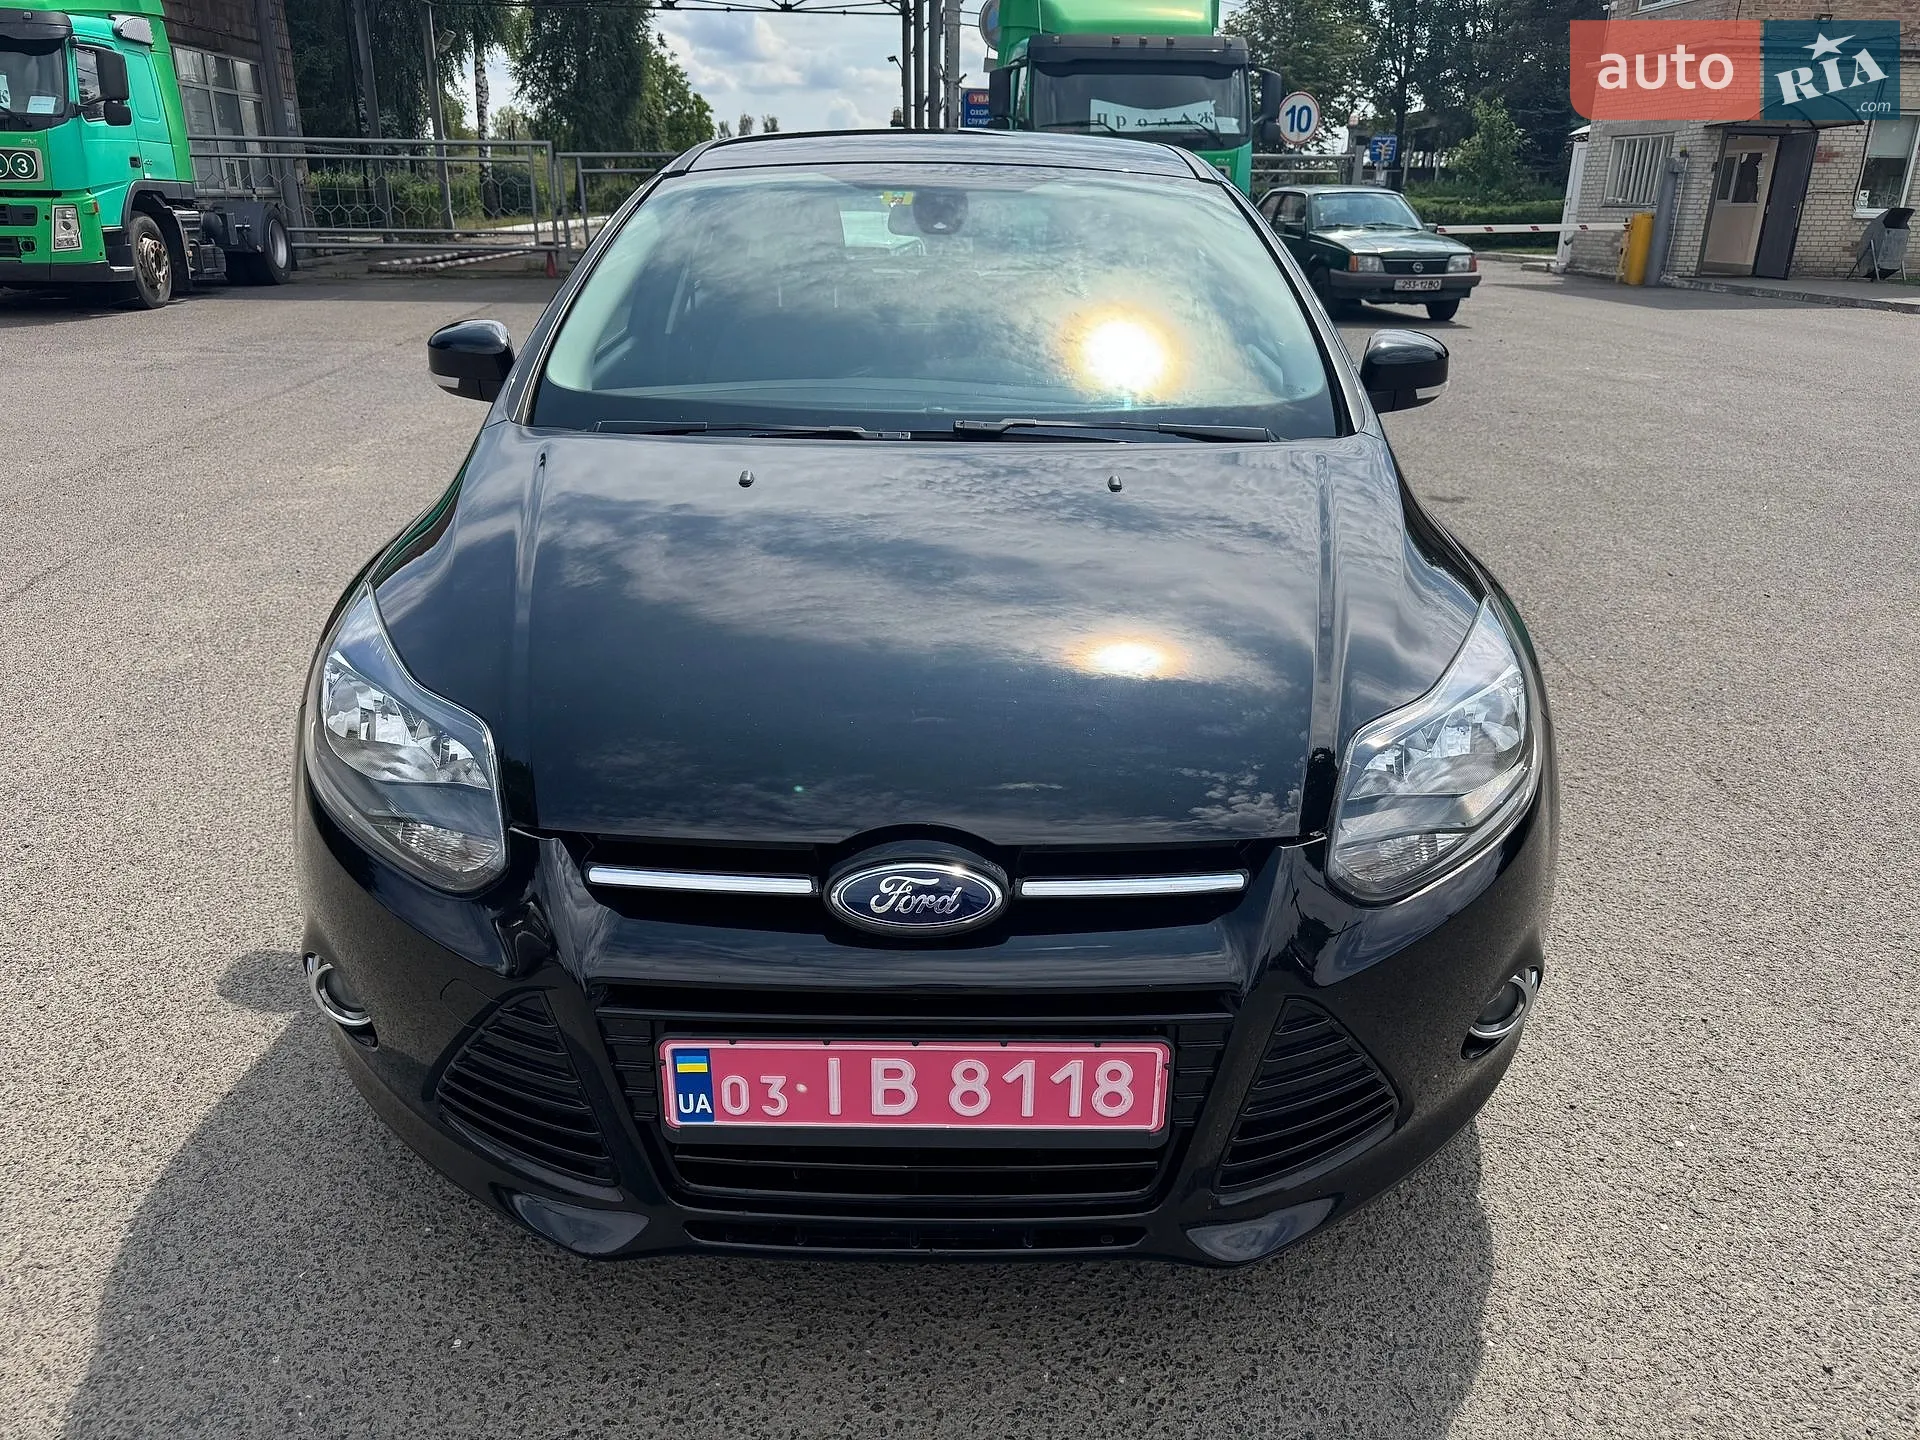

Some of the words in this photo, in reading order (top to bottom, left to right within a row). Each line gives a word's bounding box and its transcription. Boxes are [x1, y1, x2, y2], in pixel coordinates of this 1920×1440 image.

[971, 94, 990, 103] УВА
[1285, 105, 1313, 133] 10
[17, 158, 28, 173] 3
[870, 875, 962, 914] Ford
[678, 1093, 712, 1114] UA
[721, 1075, 788, 1116] 03
[949, 1059, 1134, 1117] 8118
